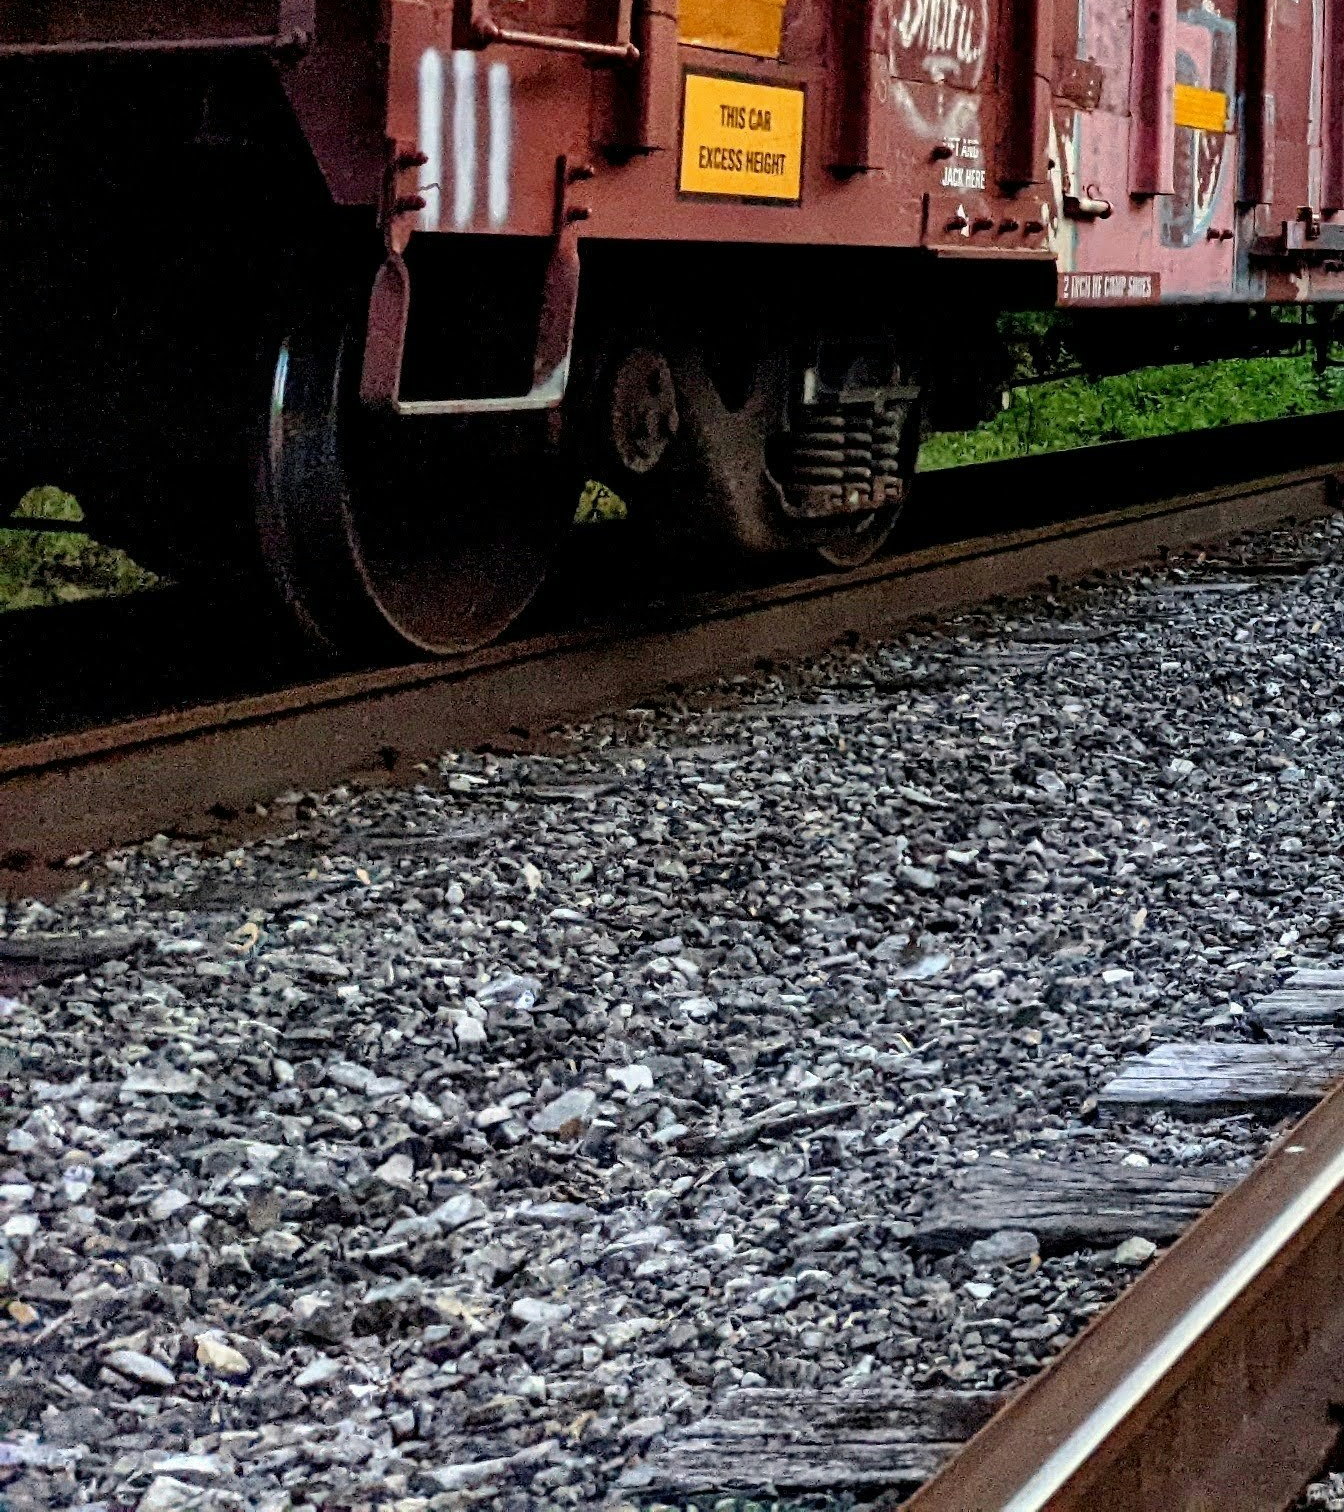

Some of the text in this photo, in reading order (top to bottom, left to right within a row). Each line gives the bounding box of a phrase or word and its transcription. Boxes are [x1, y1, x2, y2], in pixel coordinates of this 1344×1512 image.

[720, 104, 772, 132] THIS CAR
[699, 145, 787, 175] EXCESS HEIGHT
[941, 166, 986, 190] JACK HERE
